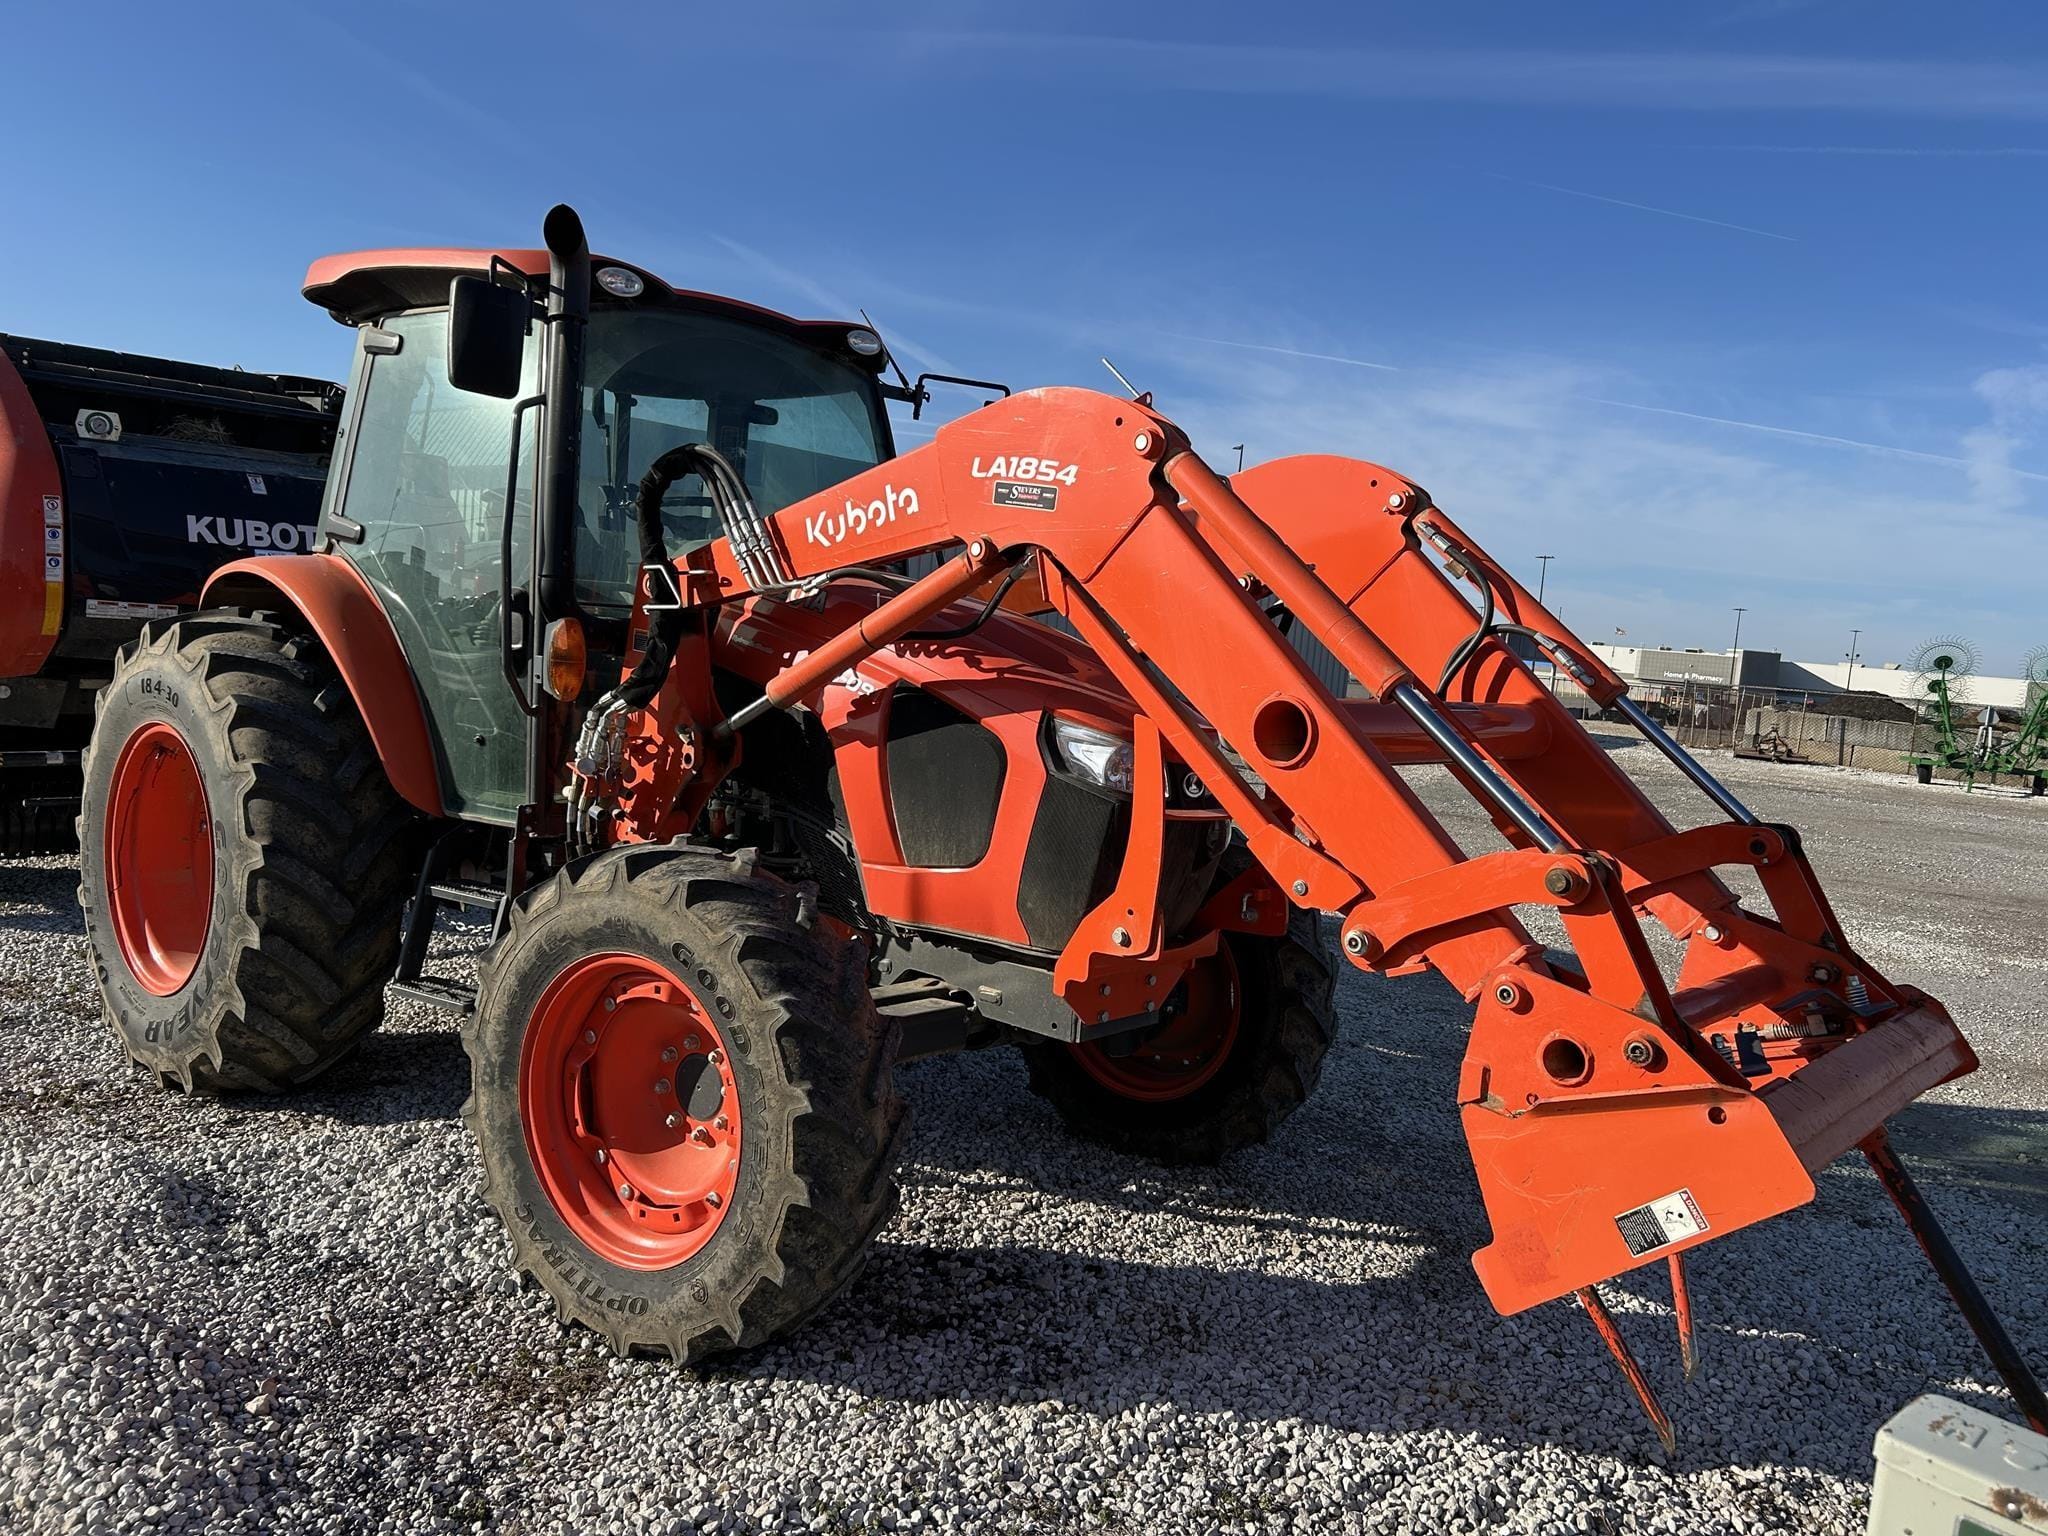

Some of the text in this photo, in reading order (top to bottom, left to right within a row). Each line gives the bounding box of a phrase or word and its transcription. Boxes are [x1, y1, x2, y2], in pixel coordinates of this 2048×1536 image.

[971, 456, 1079, 486] LA1854
[805, 484, 919, 547] Kubota
[186, 514, 318, 552] KUBOT
[1691, 672, 1723, 684] Pharmacy
[1685, 1199, 1706, 1229] DANGER
[514, 1202, 648, 1317] OPTITRAC
